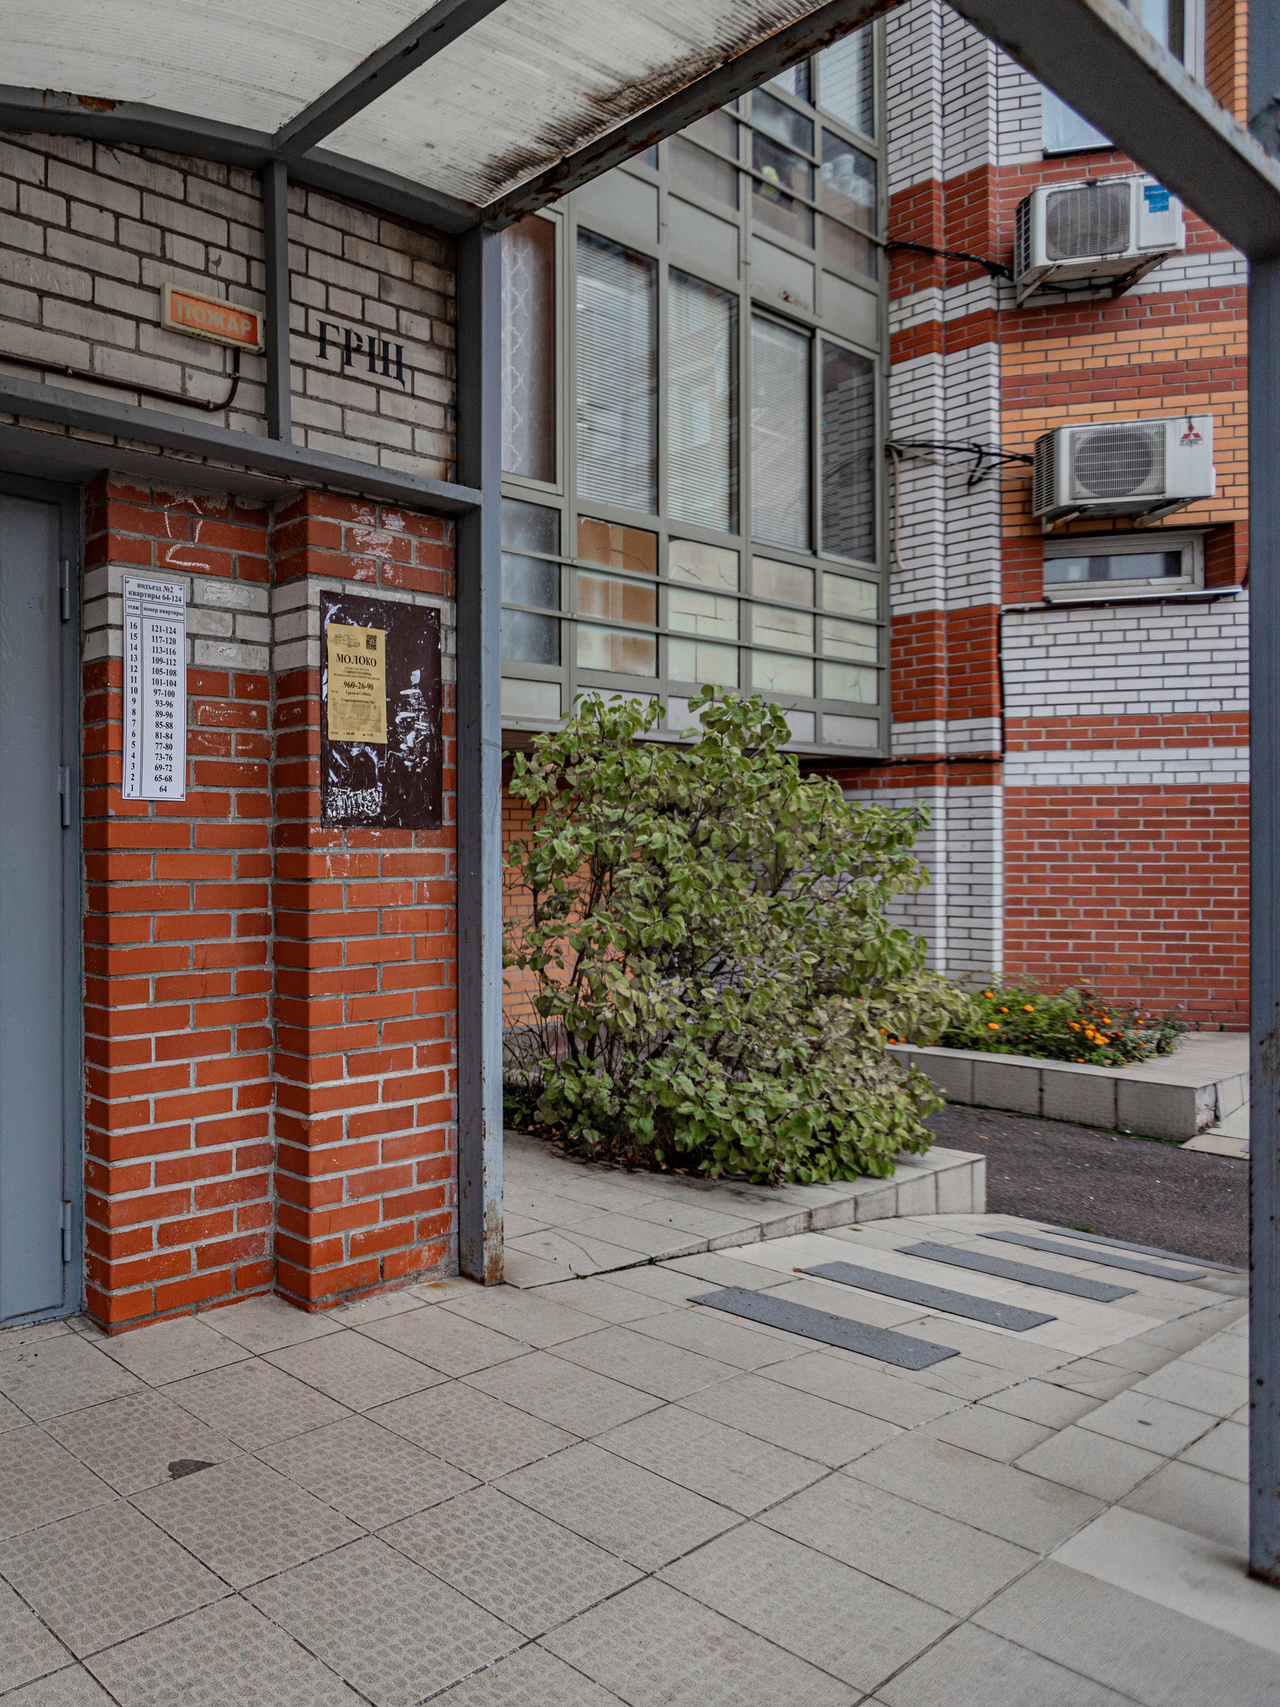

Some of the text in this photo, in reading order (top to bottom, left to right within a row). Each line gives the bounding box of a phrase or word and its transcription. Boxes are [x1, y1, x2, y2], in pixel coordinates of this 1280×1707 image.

[176, 300, 252, 337] ПОЖАР
[315, 318, 406, 389] ГРЩ
[137, 582, 174, 593] подъезд №2
[128, 590, 182, 603] квартиры 64-124
[159, 609, 183, 617] квартиры
[130, 622, 137, 630] 16
[151, 624, 177, 634] 121-124
[151, 636, 177, 645] 117-120
[130, 643, 138, 651] 14
[152, 646, 177, 655] 113-116
[130, 654, 138, 662] 13
[152, 657, 177, 666] 109-112
[336, 653, 377, 667] МОЛОКО
[152, 668, 177, 677] 105-108
[152, 678, 177, 687] 101-104
[343, 681, 374, 691] 960-26-90
[153, 689, 175, 697] 97-100
[155, 700, 173, 708] 93-96
[155, 711, 173, 719] 89-96
[132, 719, 136, 727] 7
[155, 721, 173, 729] 85-88
[155, 732, 173, 740] 81-84
[154, 753, 173, 761] 73-76
[130, 784, 134, 792] 1
